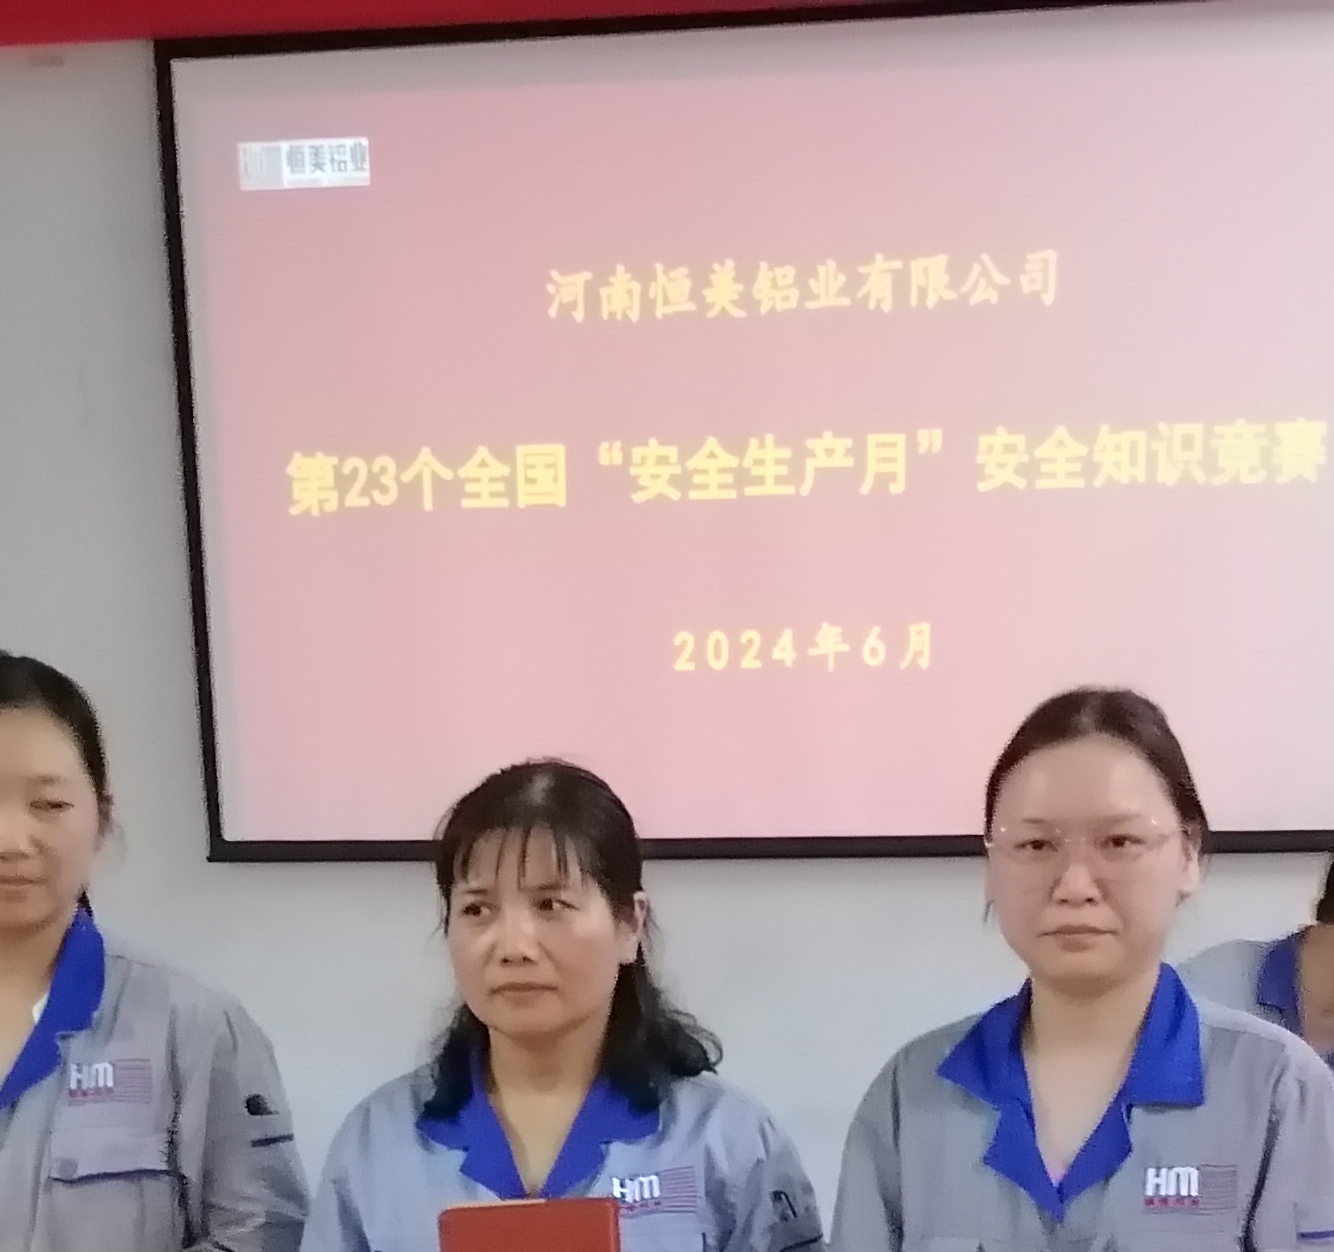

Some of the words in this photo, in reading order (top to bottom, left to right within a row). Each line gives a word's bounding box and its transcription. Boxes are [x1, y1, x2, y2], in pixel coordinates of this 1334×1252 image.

[545, 247, 1060, 324] 河南恒美铝业有限公司
[672, 621, 932, 673] 2024年6月
